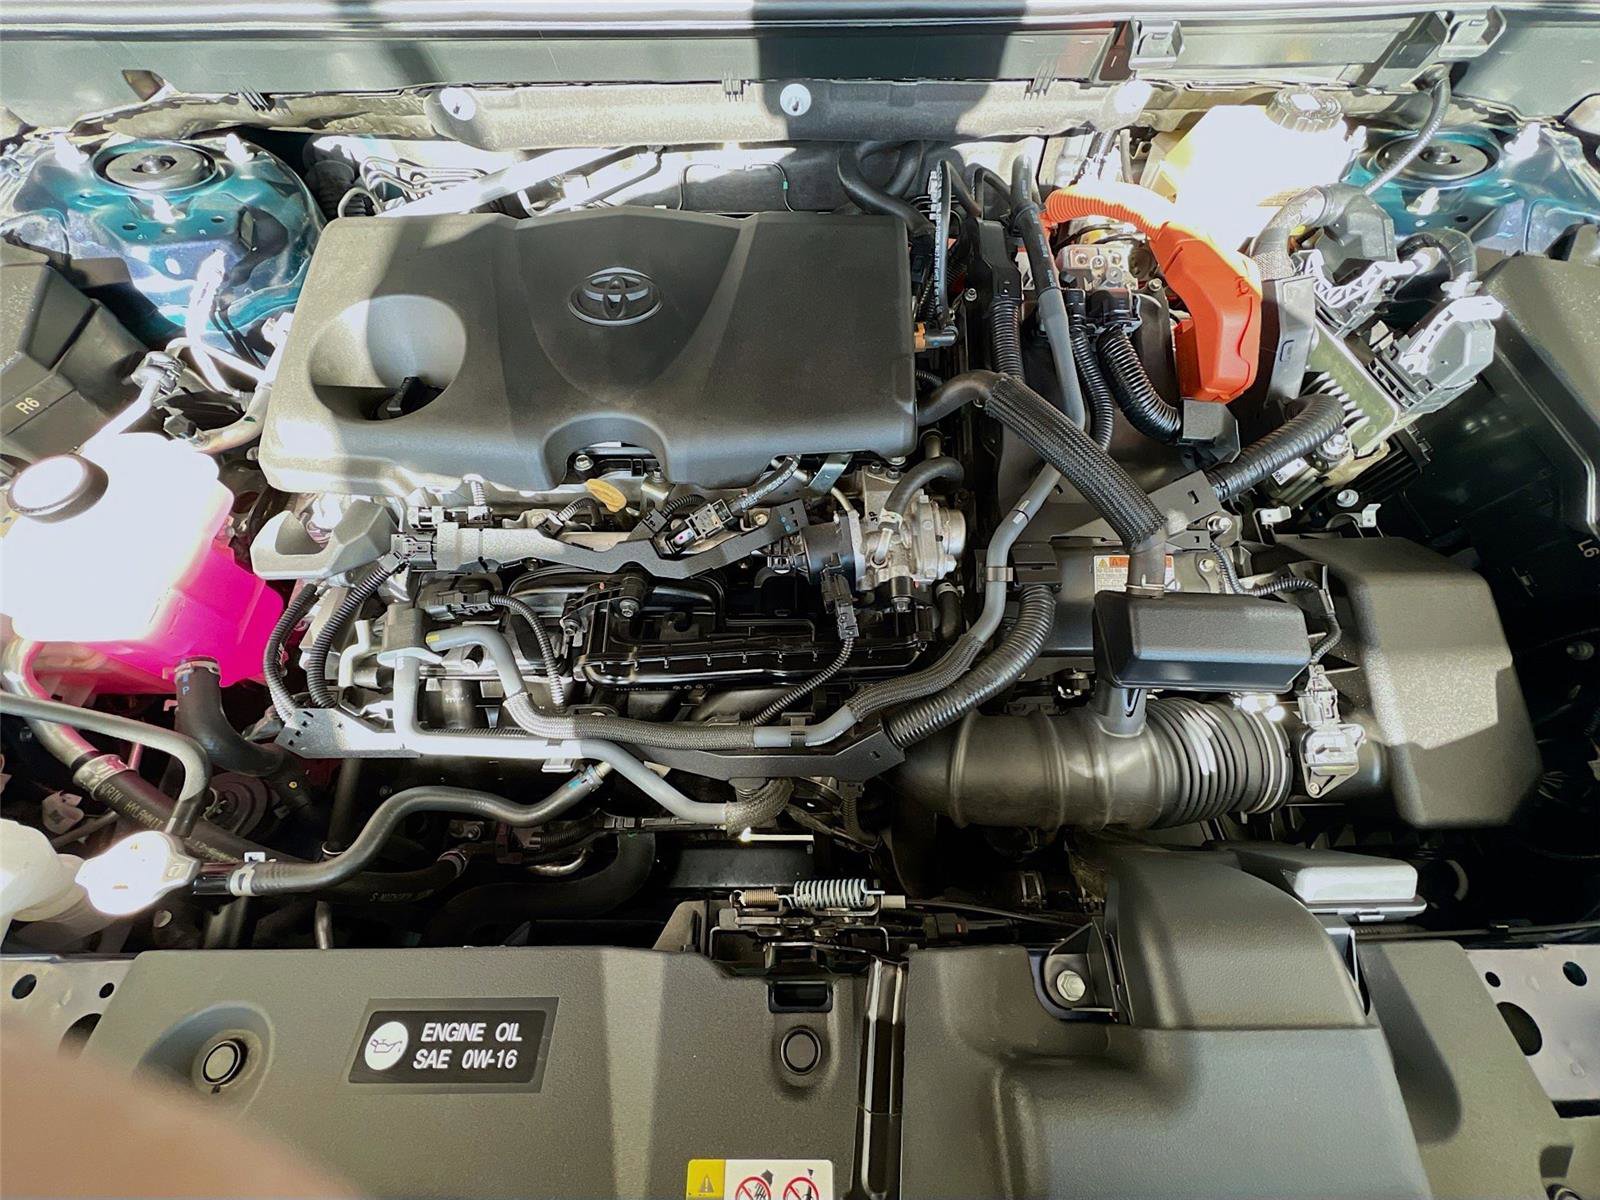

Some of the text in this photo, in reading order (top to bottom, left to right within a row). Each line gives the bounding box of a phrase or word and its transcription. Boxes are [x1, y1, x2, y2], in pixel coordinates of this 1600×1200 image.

[15, 397, 40, 414] R6
[1577, 539, 1600, 557] L6
[420, 1022, 523, 1042] ENGINE OIL
[413, 1049, 518, 1070] SAE 0W-16
